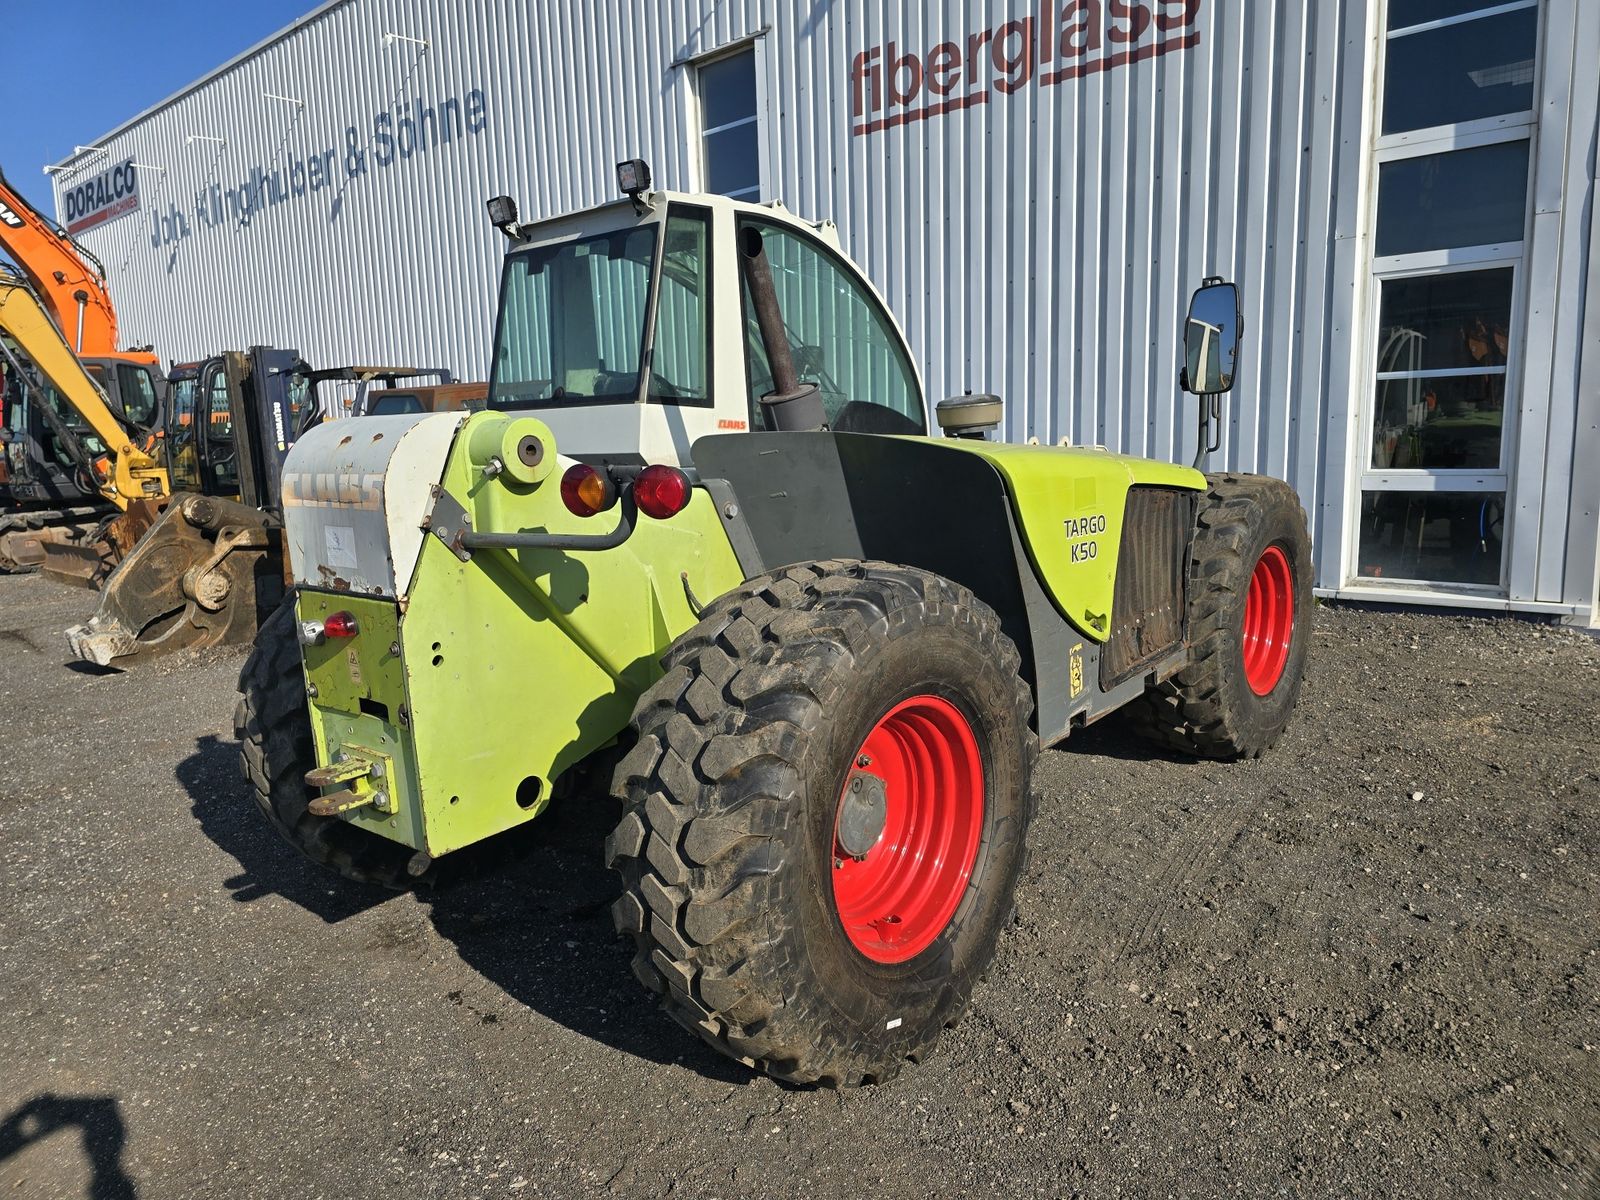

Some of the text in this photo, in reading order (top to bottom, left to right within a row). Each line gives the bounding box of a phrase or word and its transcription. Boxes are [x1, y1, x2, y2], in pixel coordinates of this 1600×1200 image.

[345, 126, 368, 179] &
[374, 88, 487, 168] Söhne
[66, 160, 136, 222] DORALCO
[107, 194, 138, 219] MACHINES
[718, 419, 746, 430] CLAAS
[1063, 515, 1106, 538] TARGO
[1071, 541, 1097, 563] K50
